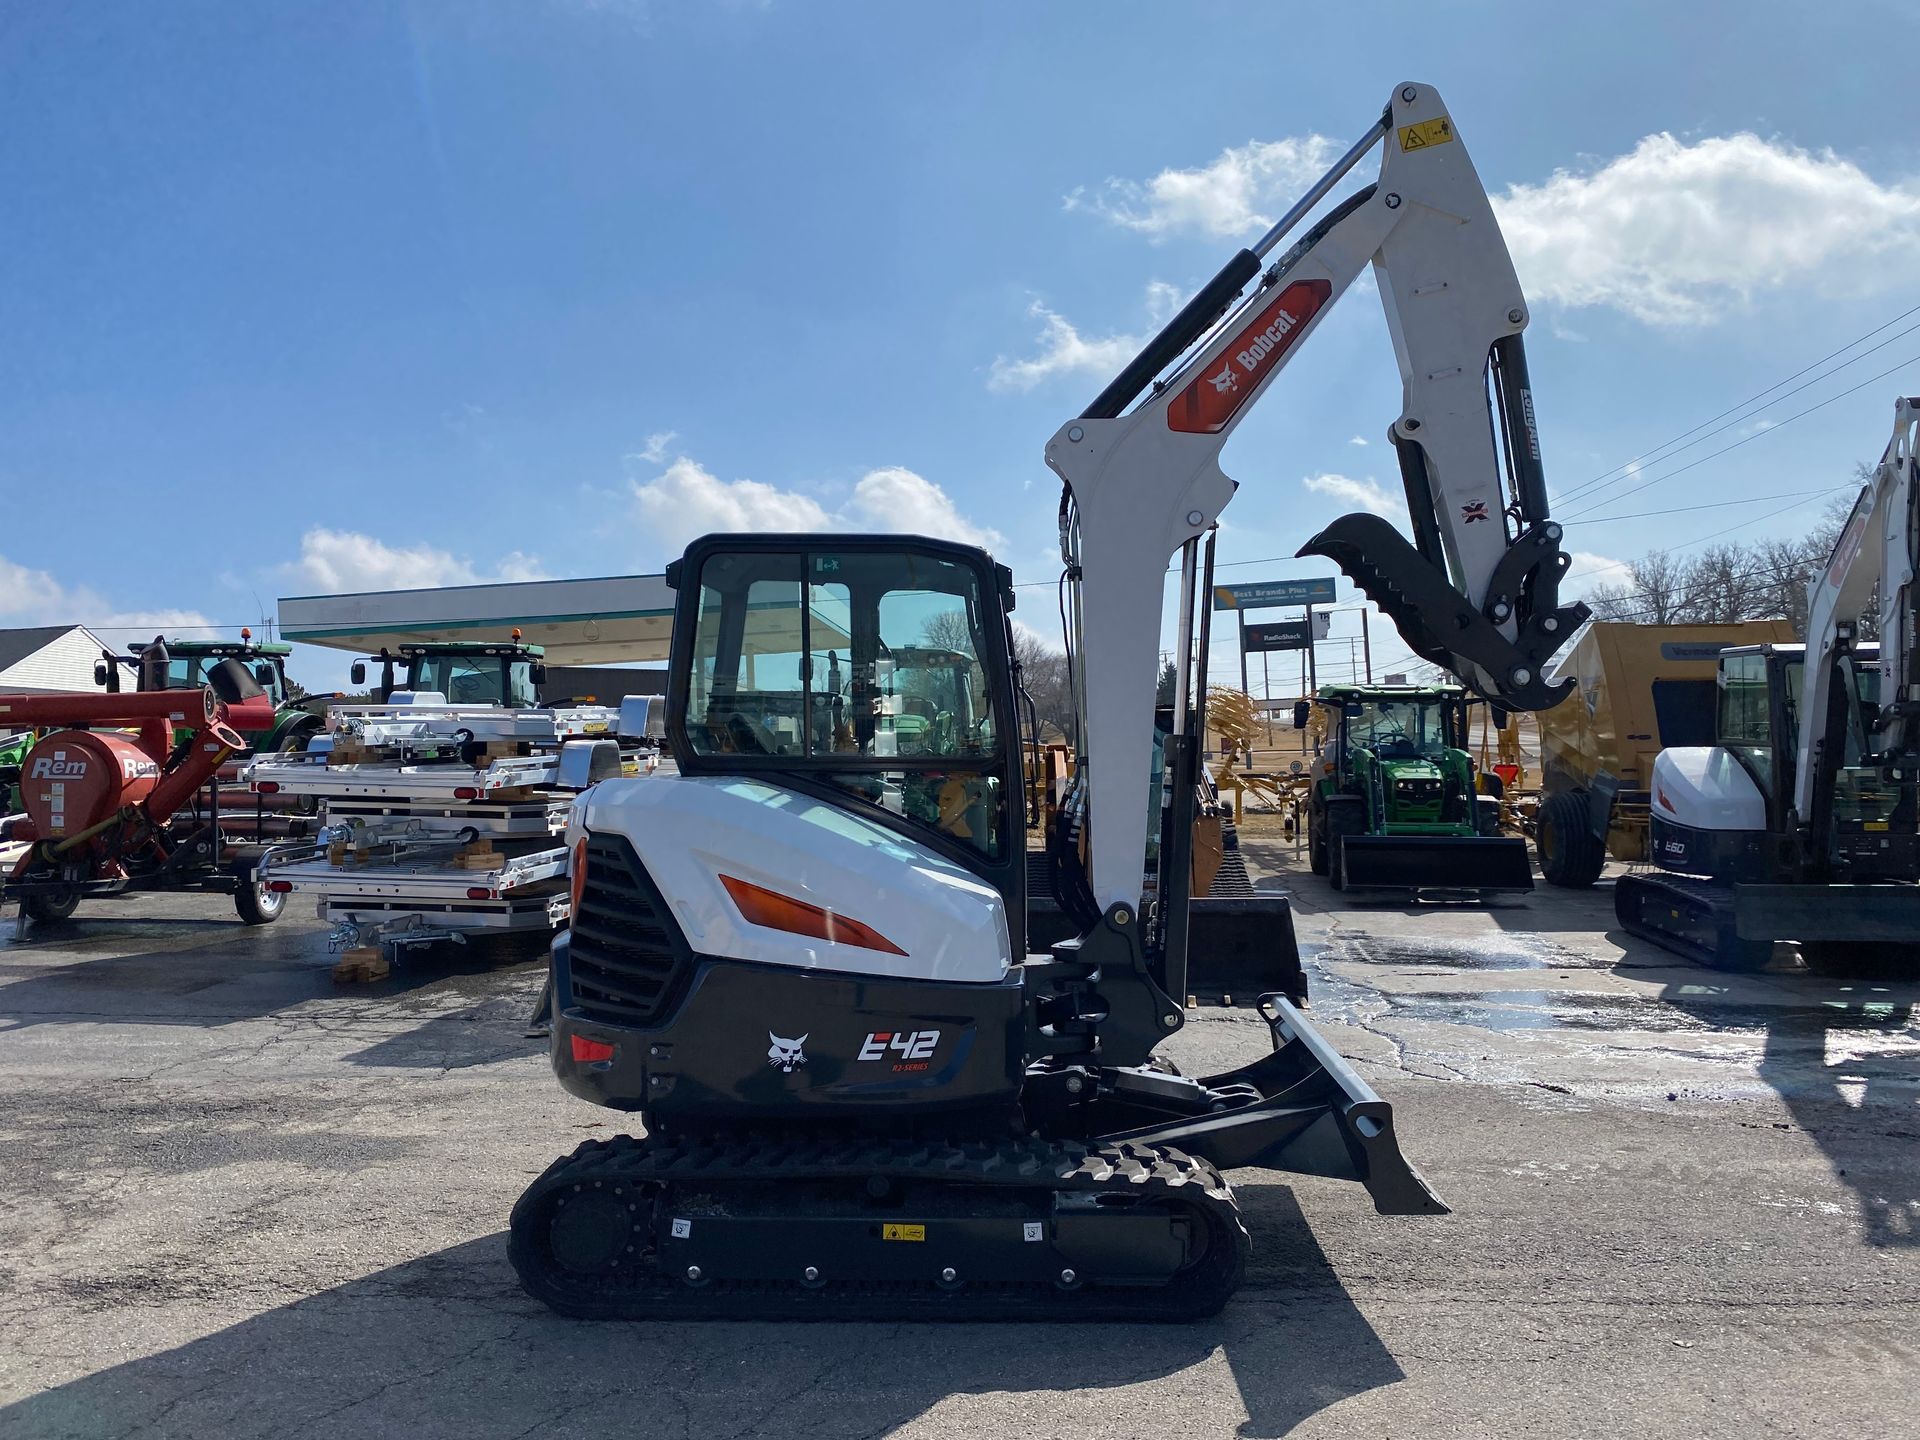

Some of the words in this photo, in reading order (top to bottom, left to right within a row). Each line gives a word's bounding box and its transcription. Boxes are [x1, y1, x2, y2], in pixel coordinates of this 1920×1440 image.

[1236, 309, 1297, 372] Bobcat
[1520, 388, 1540, 460] LongArm
[1255, 588, 1286, 596] Brands
[1263, 632, 1301, 641] RadioShack
[31, 757, 87, 779] Rem
[123, 758, 159, 779] Rem
[857, 1030, 941, 1061] E42
[892, 1062, 929, 1072] R2-SERIES
